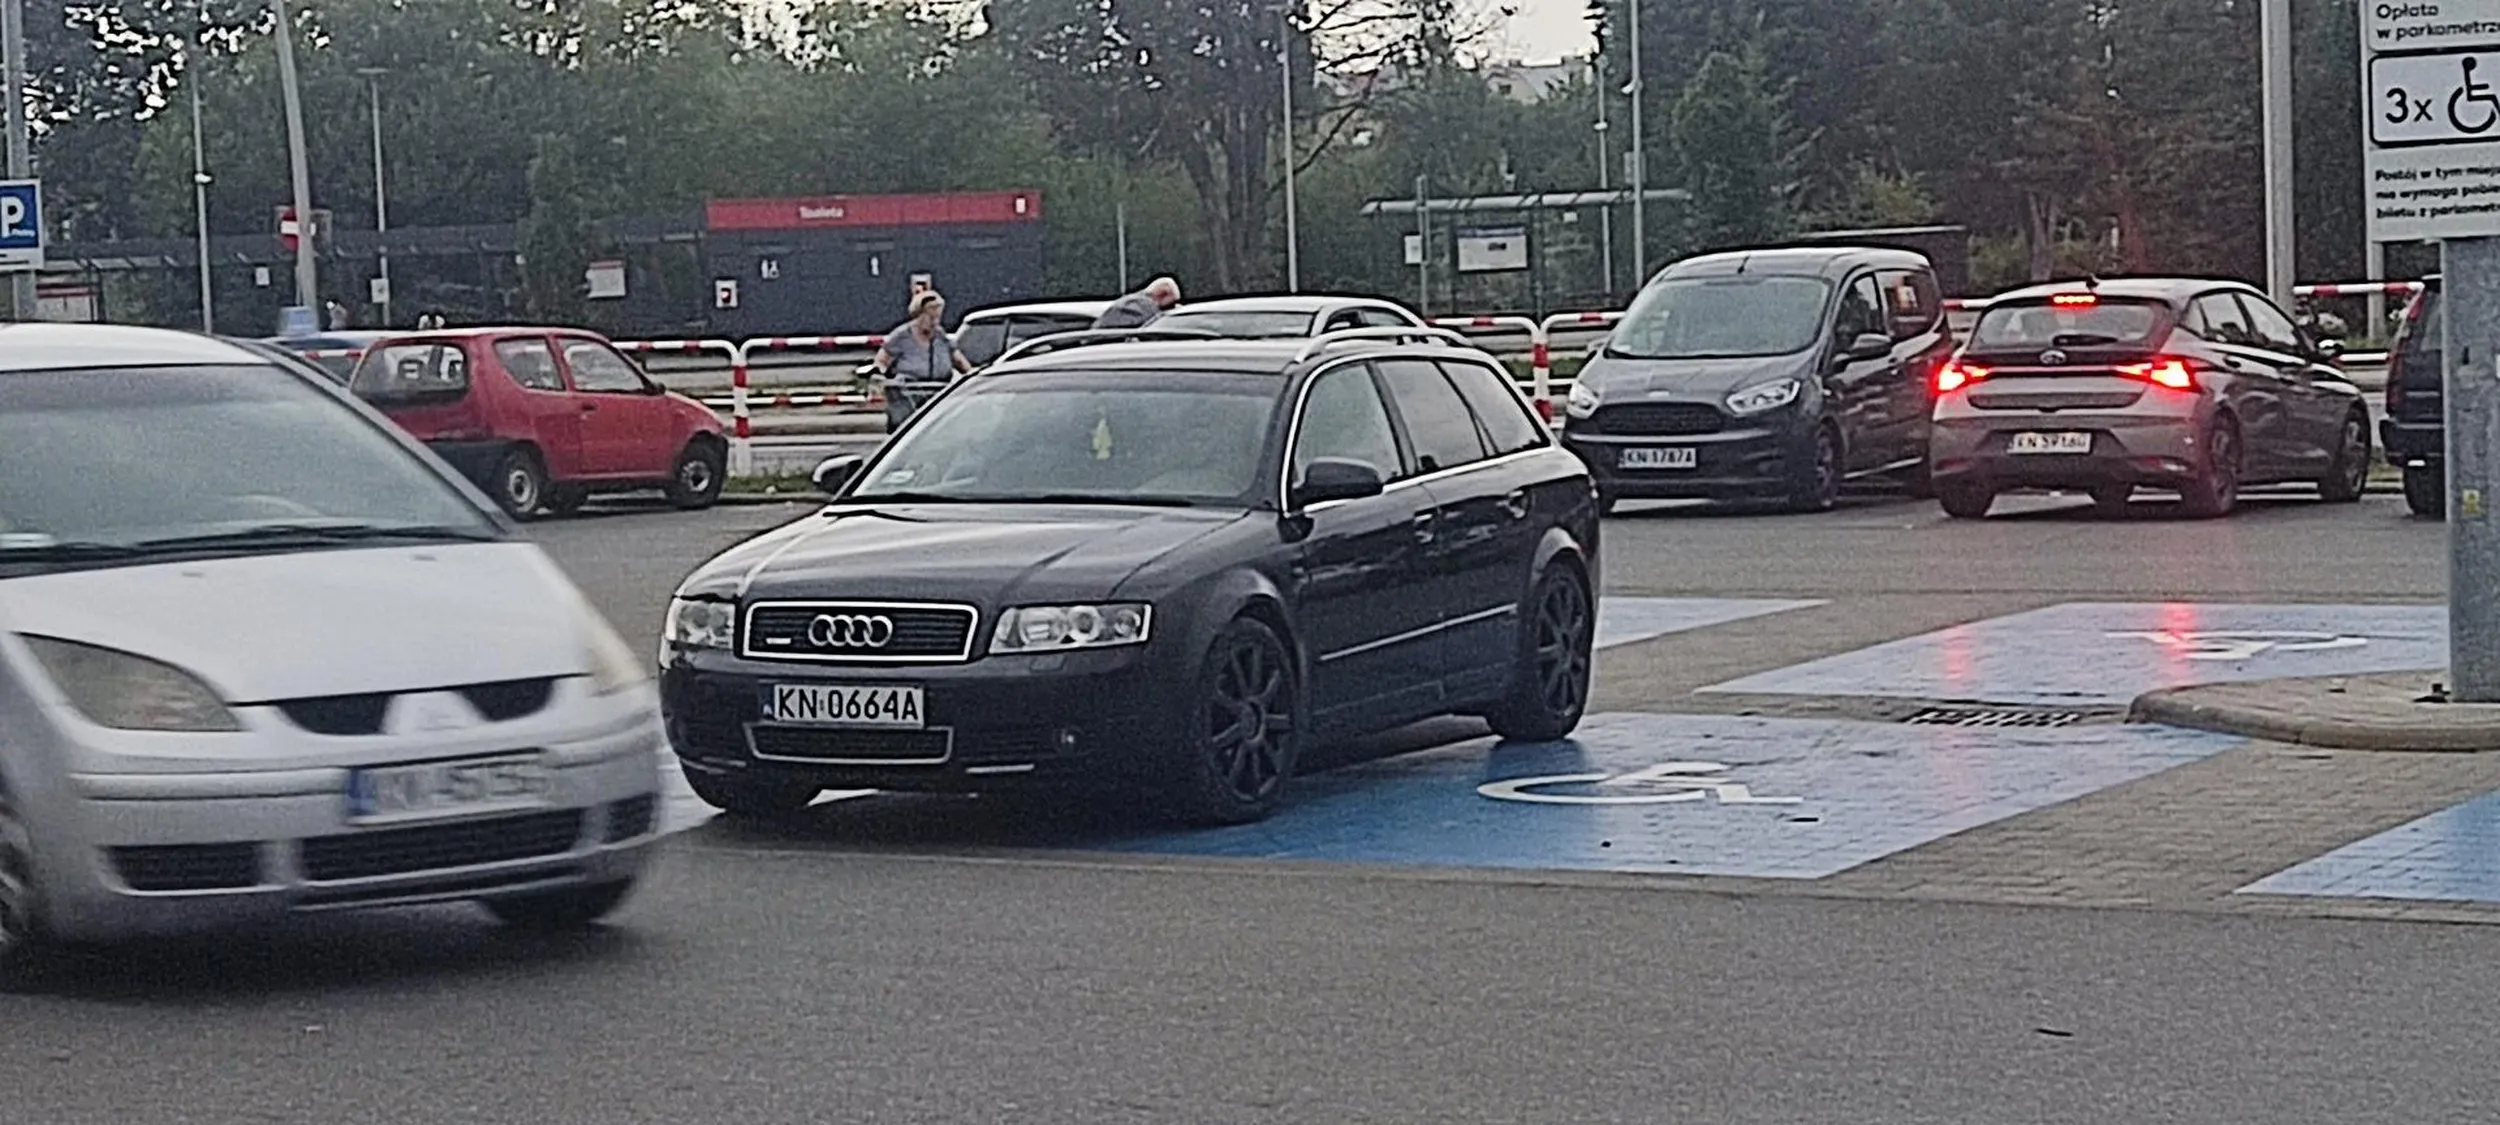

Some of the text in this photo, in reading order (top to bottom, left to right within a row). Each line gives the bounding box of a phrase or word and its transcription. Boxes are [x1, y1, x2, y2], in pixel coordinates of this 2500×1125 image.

[2376, 3, 2439, 21] Opłata
[2376, 29, 2391, 39] w
[2385, 87, 2433, 123] 3x
[2420, 171, 2432, 179] w
[2435, 167, 2463, 180] tym
[1, 196, 25, 238] P
[778, 687, 919, 721] KN 0664A
